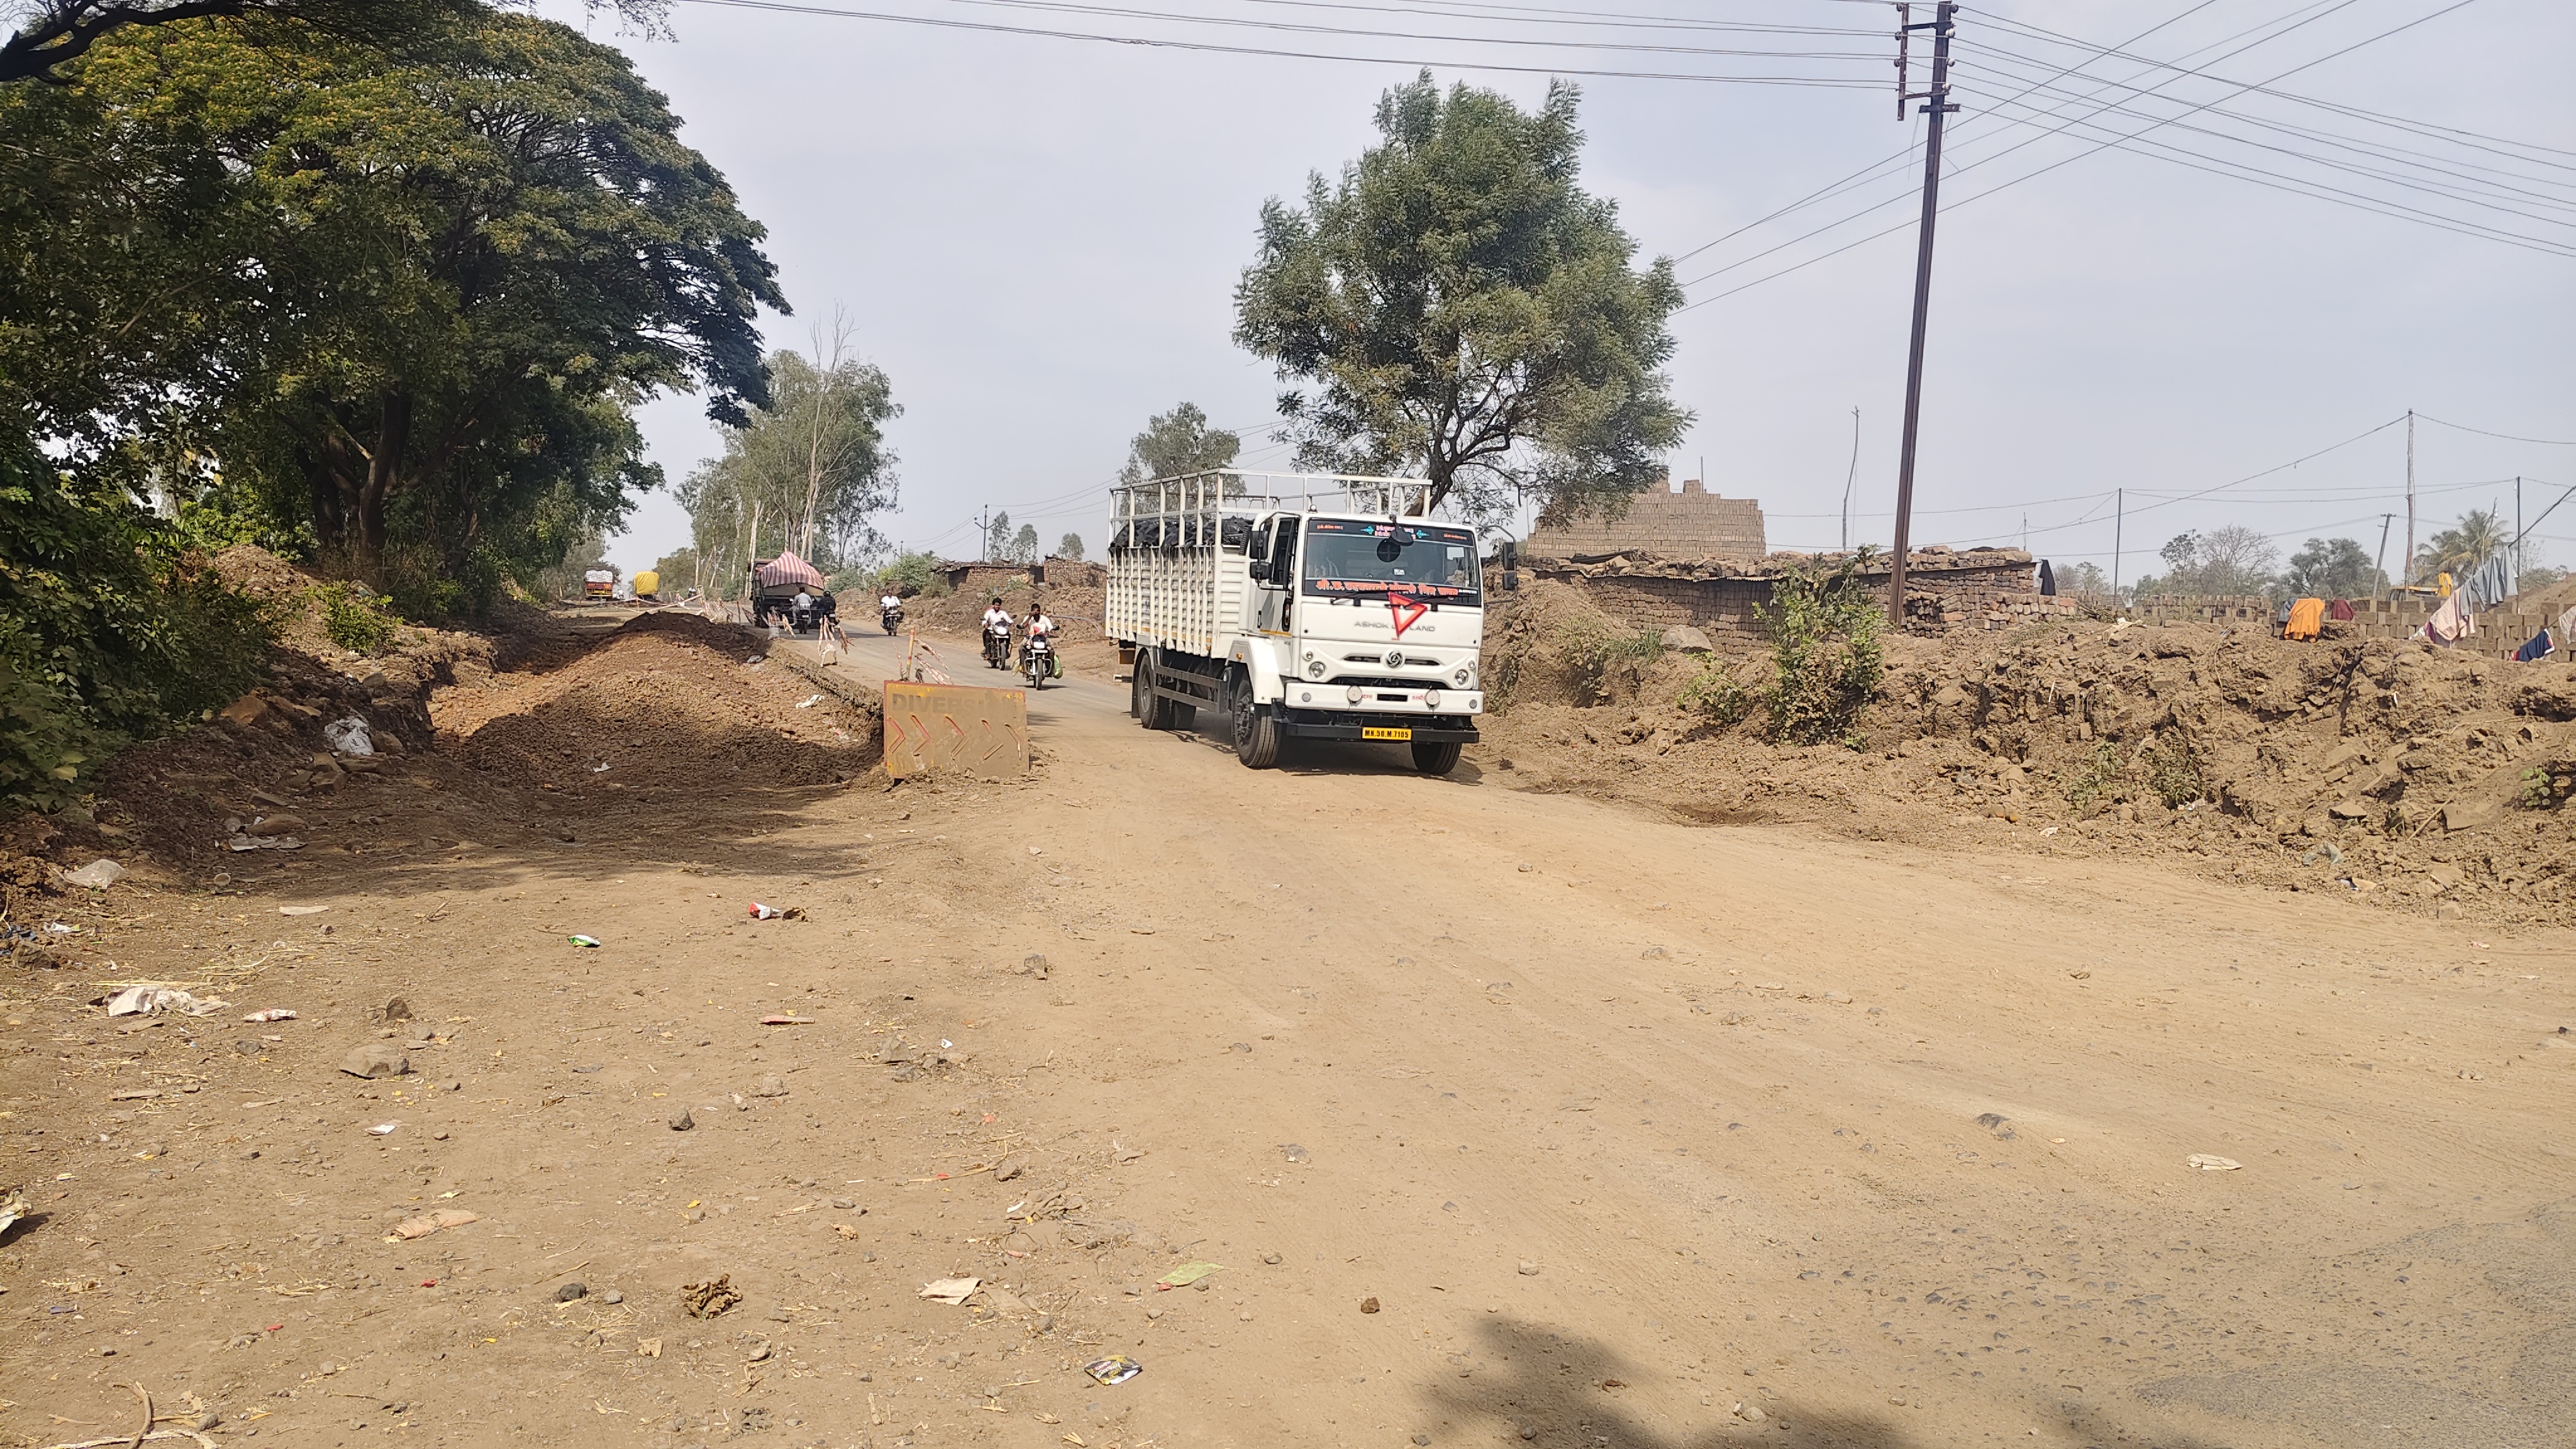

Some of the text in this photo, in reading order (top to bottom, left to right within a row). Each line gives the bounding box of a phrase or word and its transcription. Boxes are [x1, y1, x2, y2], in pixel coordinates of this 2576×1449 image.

[1354, 621, 1436, 632] ASHOK LLAND
[892, 693, 1017, 717] DIVERS
